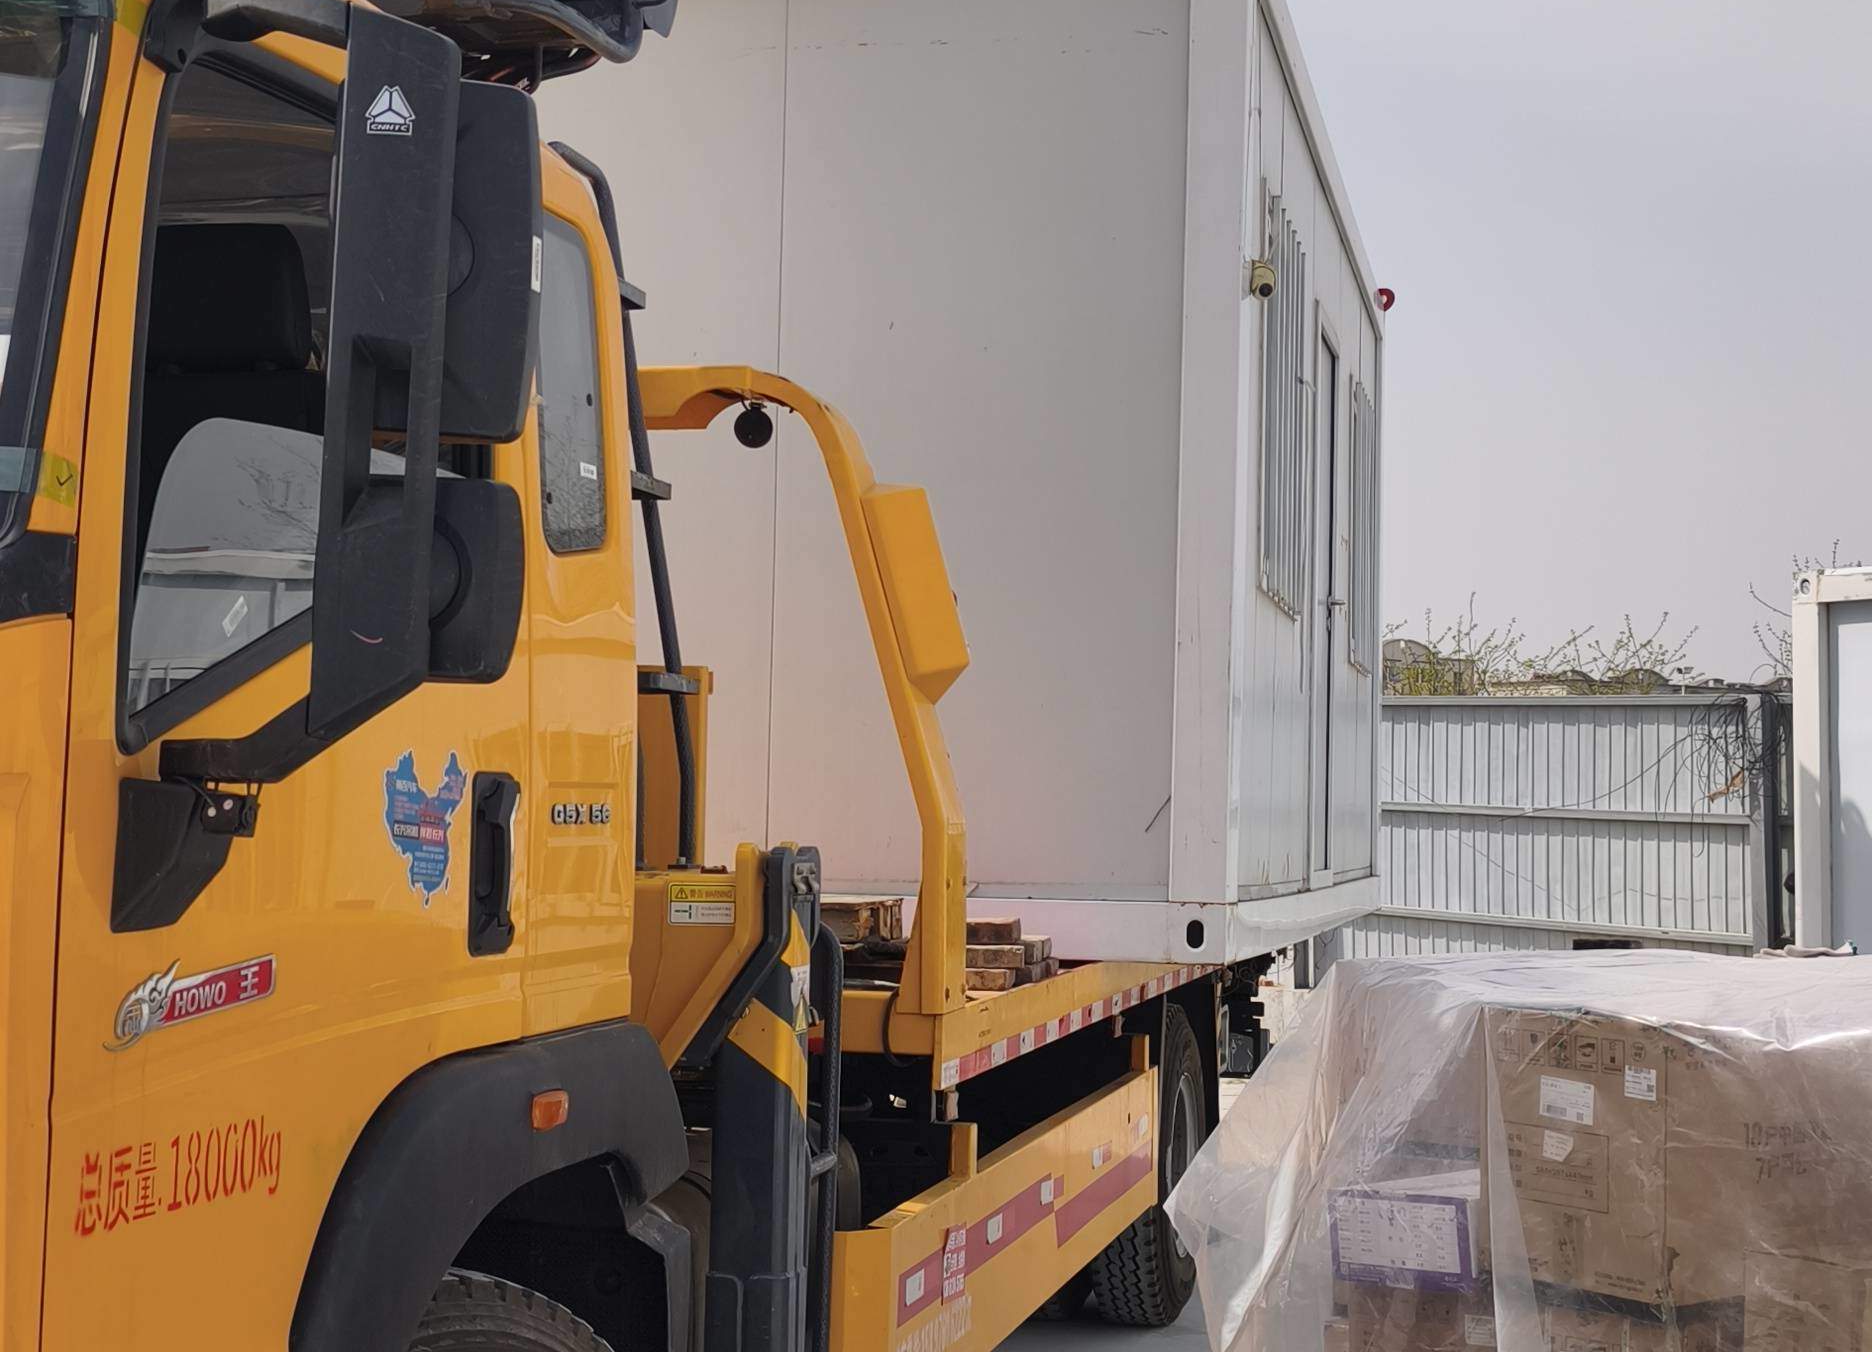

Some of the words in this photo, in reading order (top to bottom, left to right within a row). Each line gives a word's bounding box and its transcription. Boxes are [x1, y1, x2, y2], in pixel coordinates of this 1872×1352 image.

[370, 123, 408, 132] CNHTC
[173, 981, 227, 1018] HOWO
[239, 965, 260, 1000] 王
